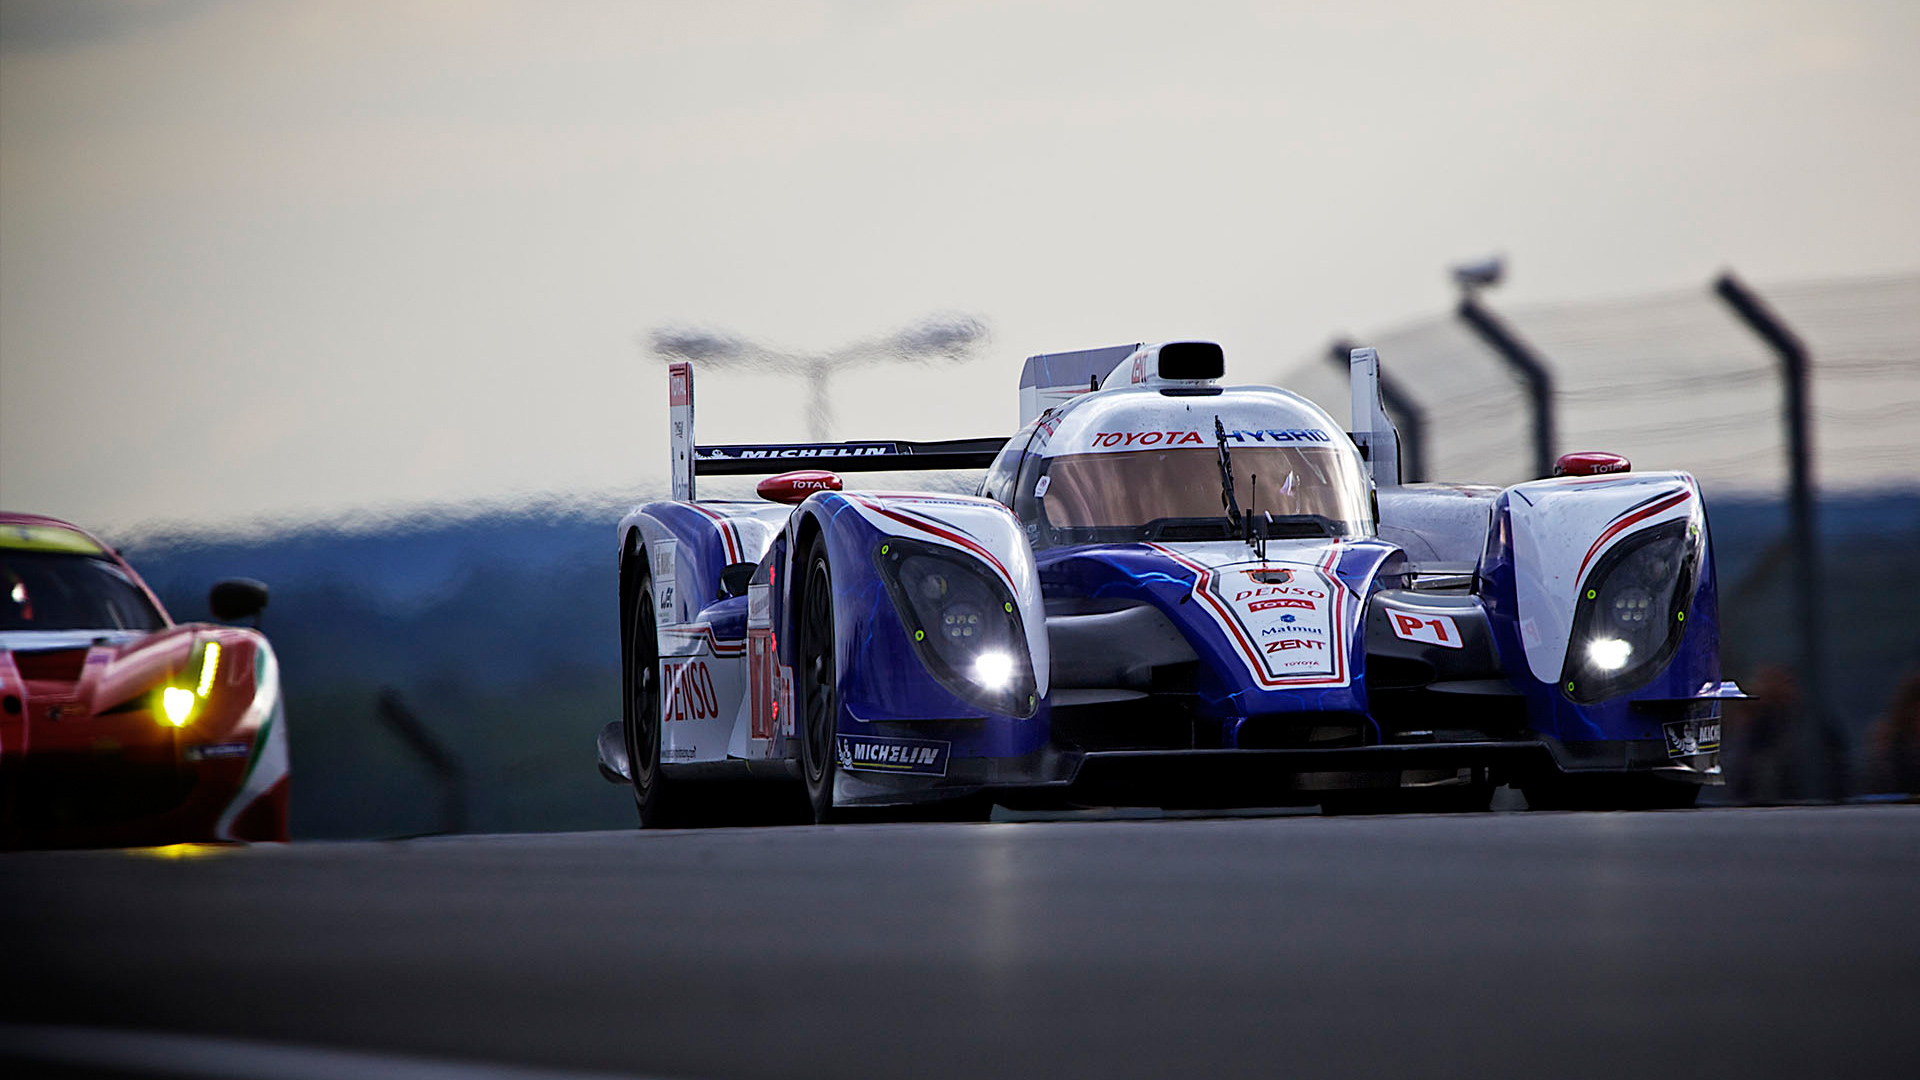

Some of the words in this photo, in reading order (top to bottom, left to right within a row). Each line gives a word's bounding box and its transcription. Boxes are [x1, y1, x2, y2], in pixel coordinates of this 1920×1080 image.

[1091, 432, 1204, 447] TOYOTA
[1216, 428, 1331, 442] HYBRID
[740, 448, 886, 458] MICHELIN
[793, 480, 830, 489] TOTAL
[1235, 587, 1325, 601] DENSO
[1252, 601, 1313, 609] TOTAL
[1262, 626, 1322, 636] Matmut
[1395, 614, 1449, 641] P1
[1265, 639, 1326, 654] ZENT
[664, 661, 718, 721] DENSO
[854, 743, 939, 764] MICHELIN
